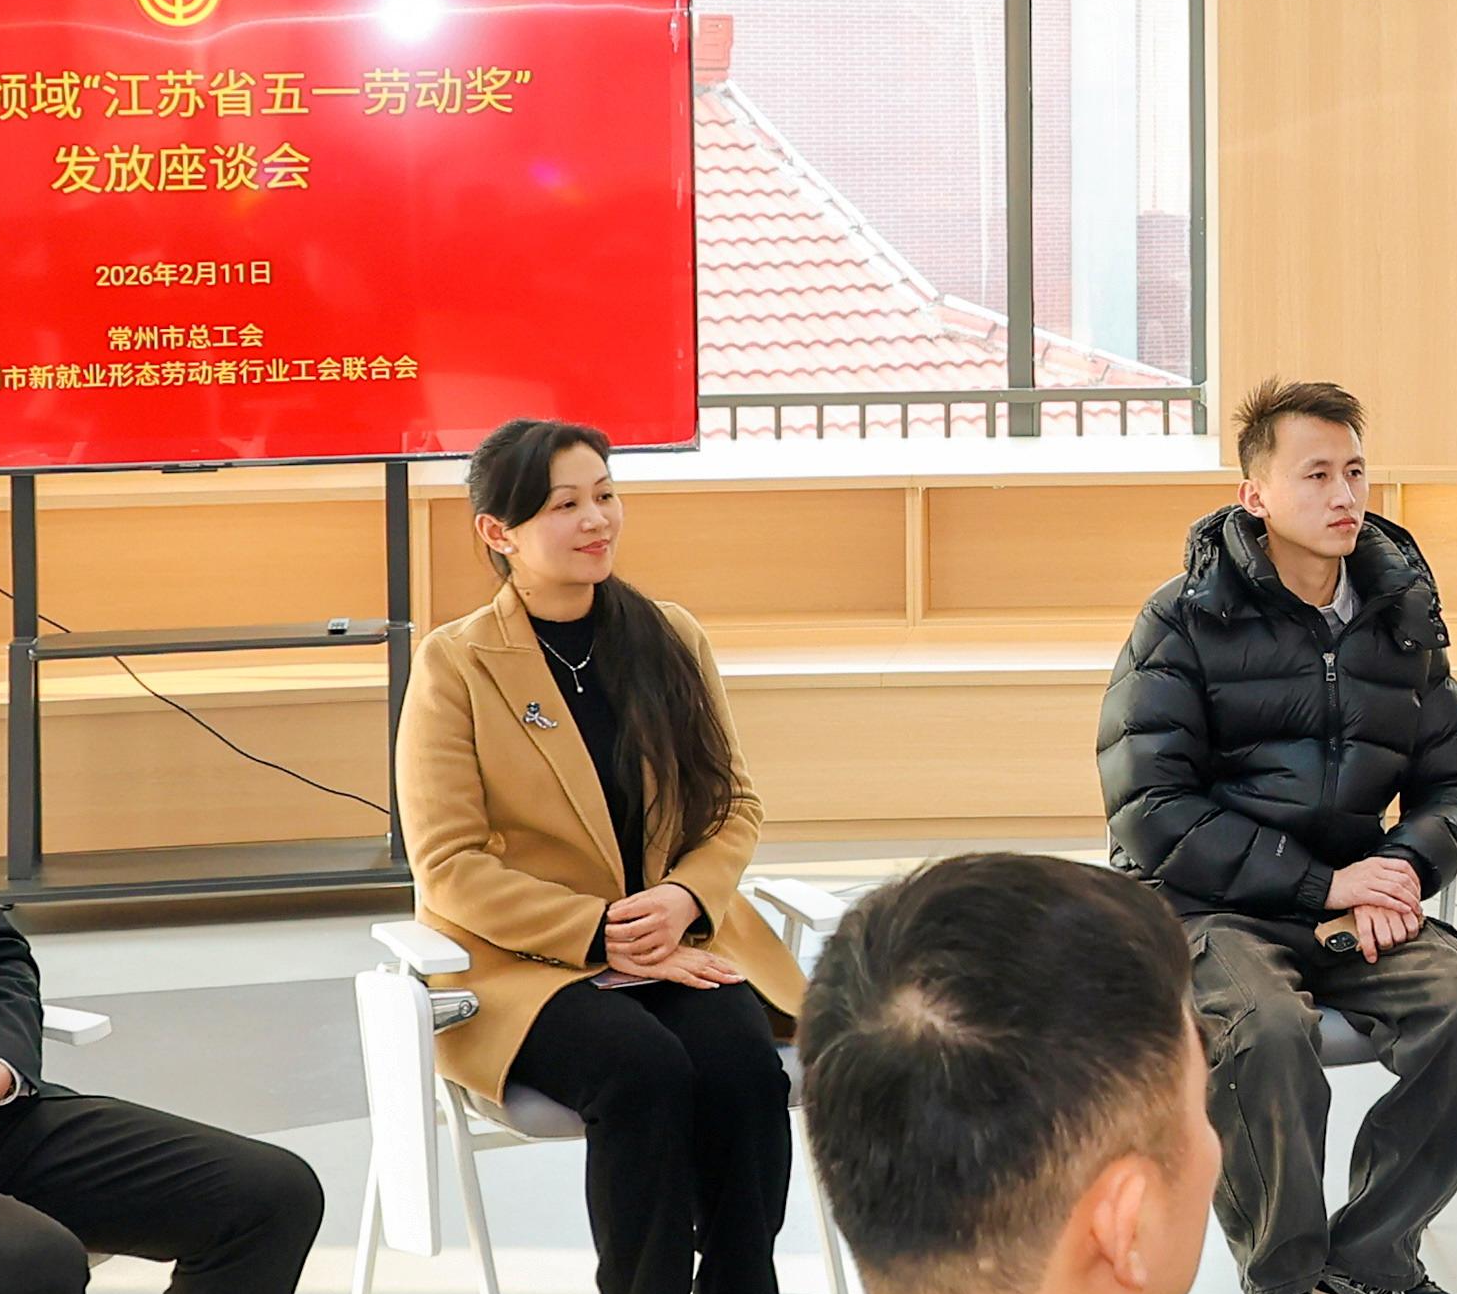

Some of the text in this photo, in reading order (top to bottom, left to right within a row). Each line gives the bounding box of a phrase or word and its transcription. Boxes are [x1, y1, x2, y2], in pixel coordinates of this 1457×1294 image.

[51, 141, 311, 194] 发放座谈会
[95, 261, 272, 288] 2026年2月11日
[107, 322, 264, 352] 常州市总工会
